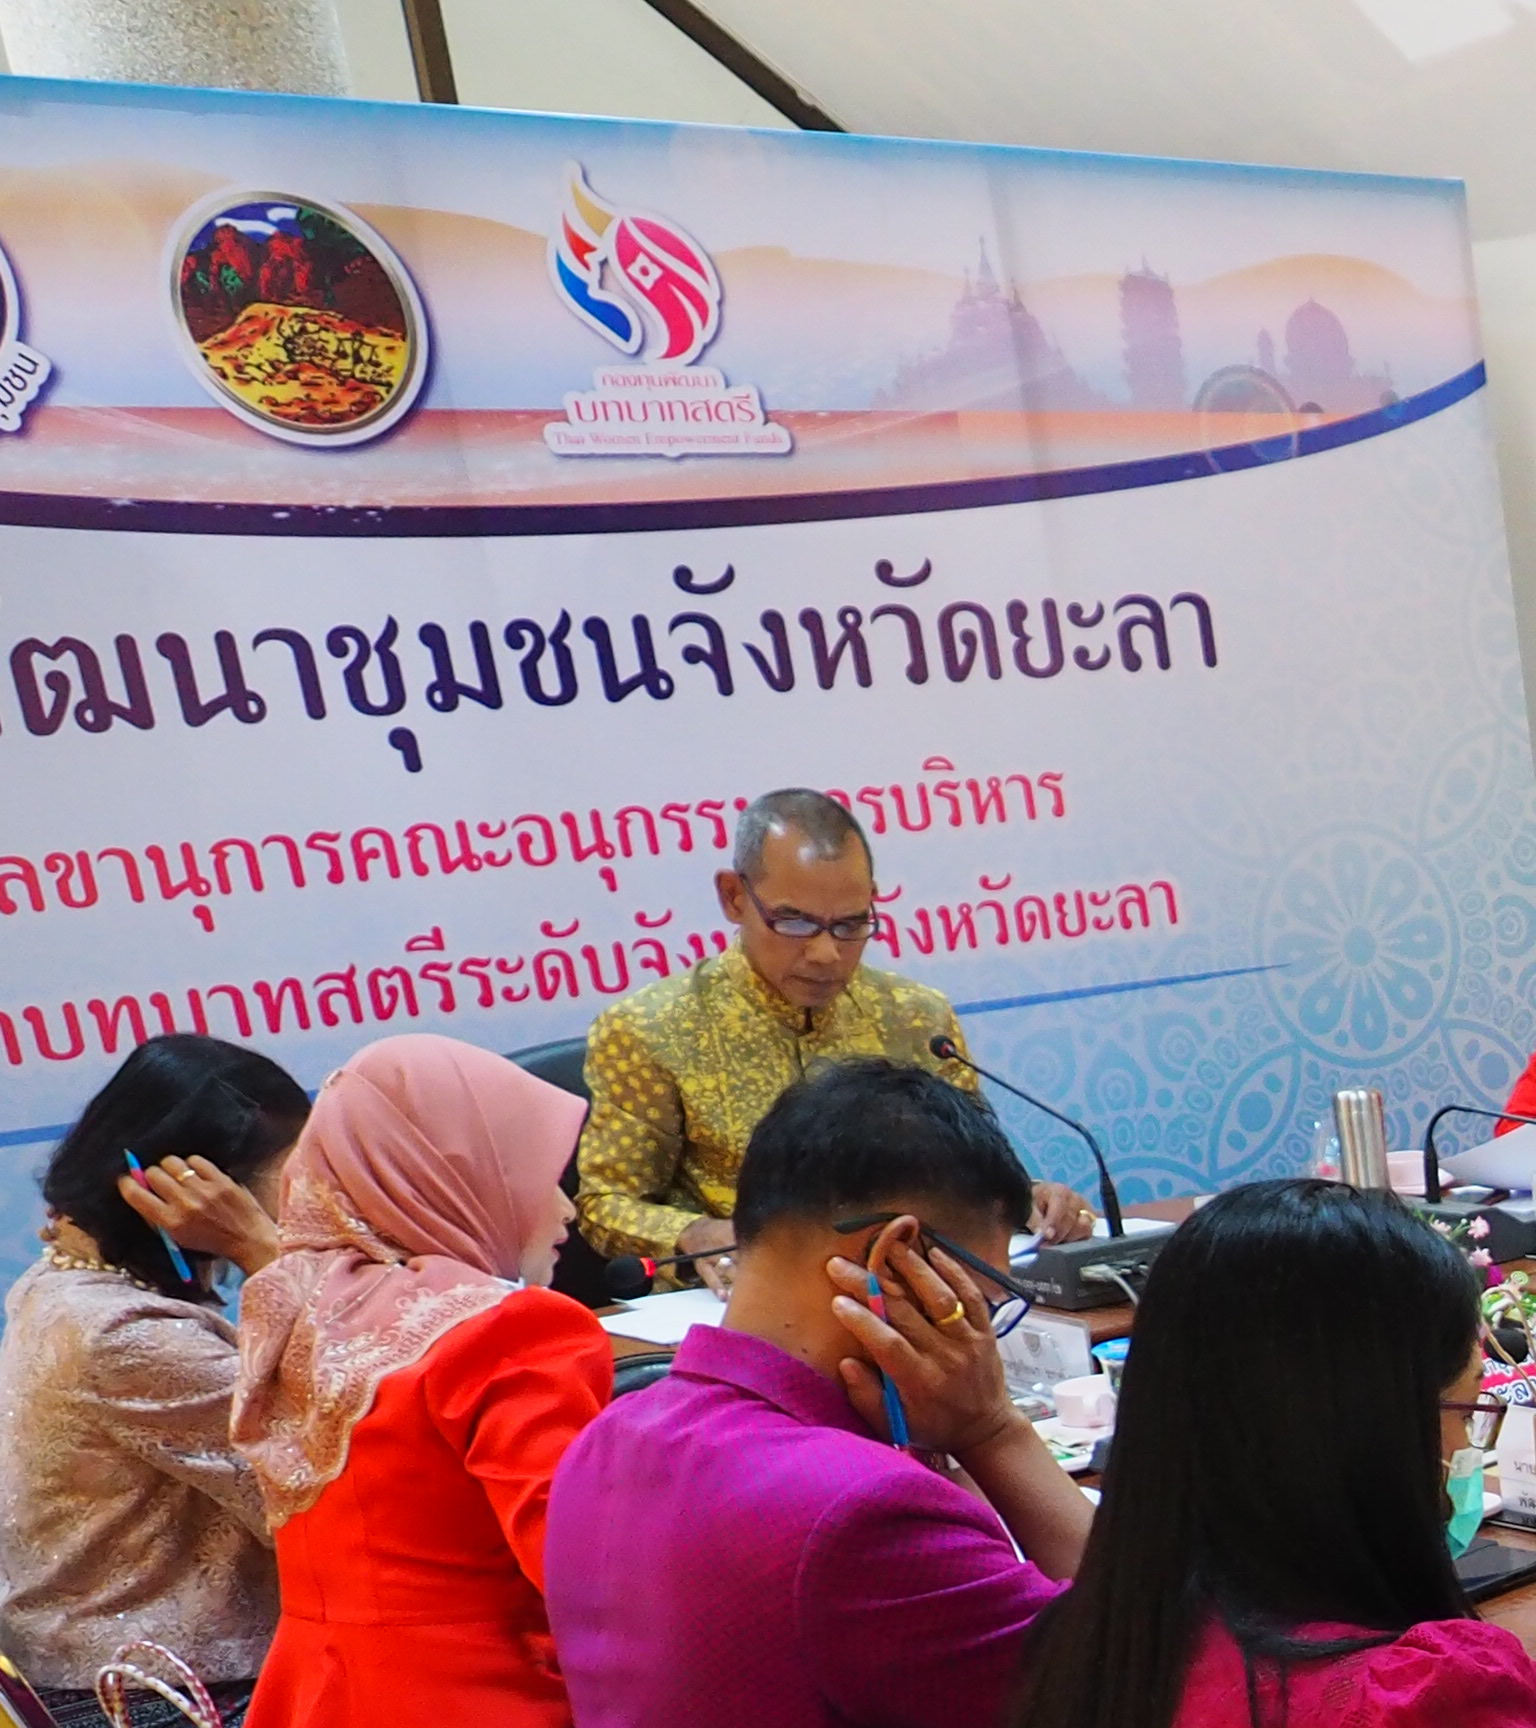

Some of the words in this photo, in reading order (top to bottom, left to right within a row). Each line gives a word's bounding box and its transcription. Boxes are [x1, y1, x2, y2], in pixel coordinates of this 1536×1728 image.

[573, 393, 757, 423] บทบาทสตรี
[589, 432, 640, 445] Women
[6, 559, 1218, 773] ฒนาชุมชนจังหวัดยะลา
